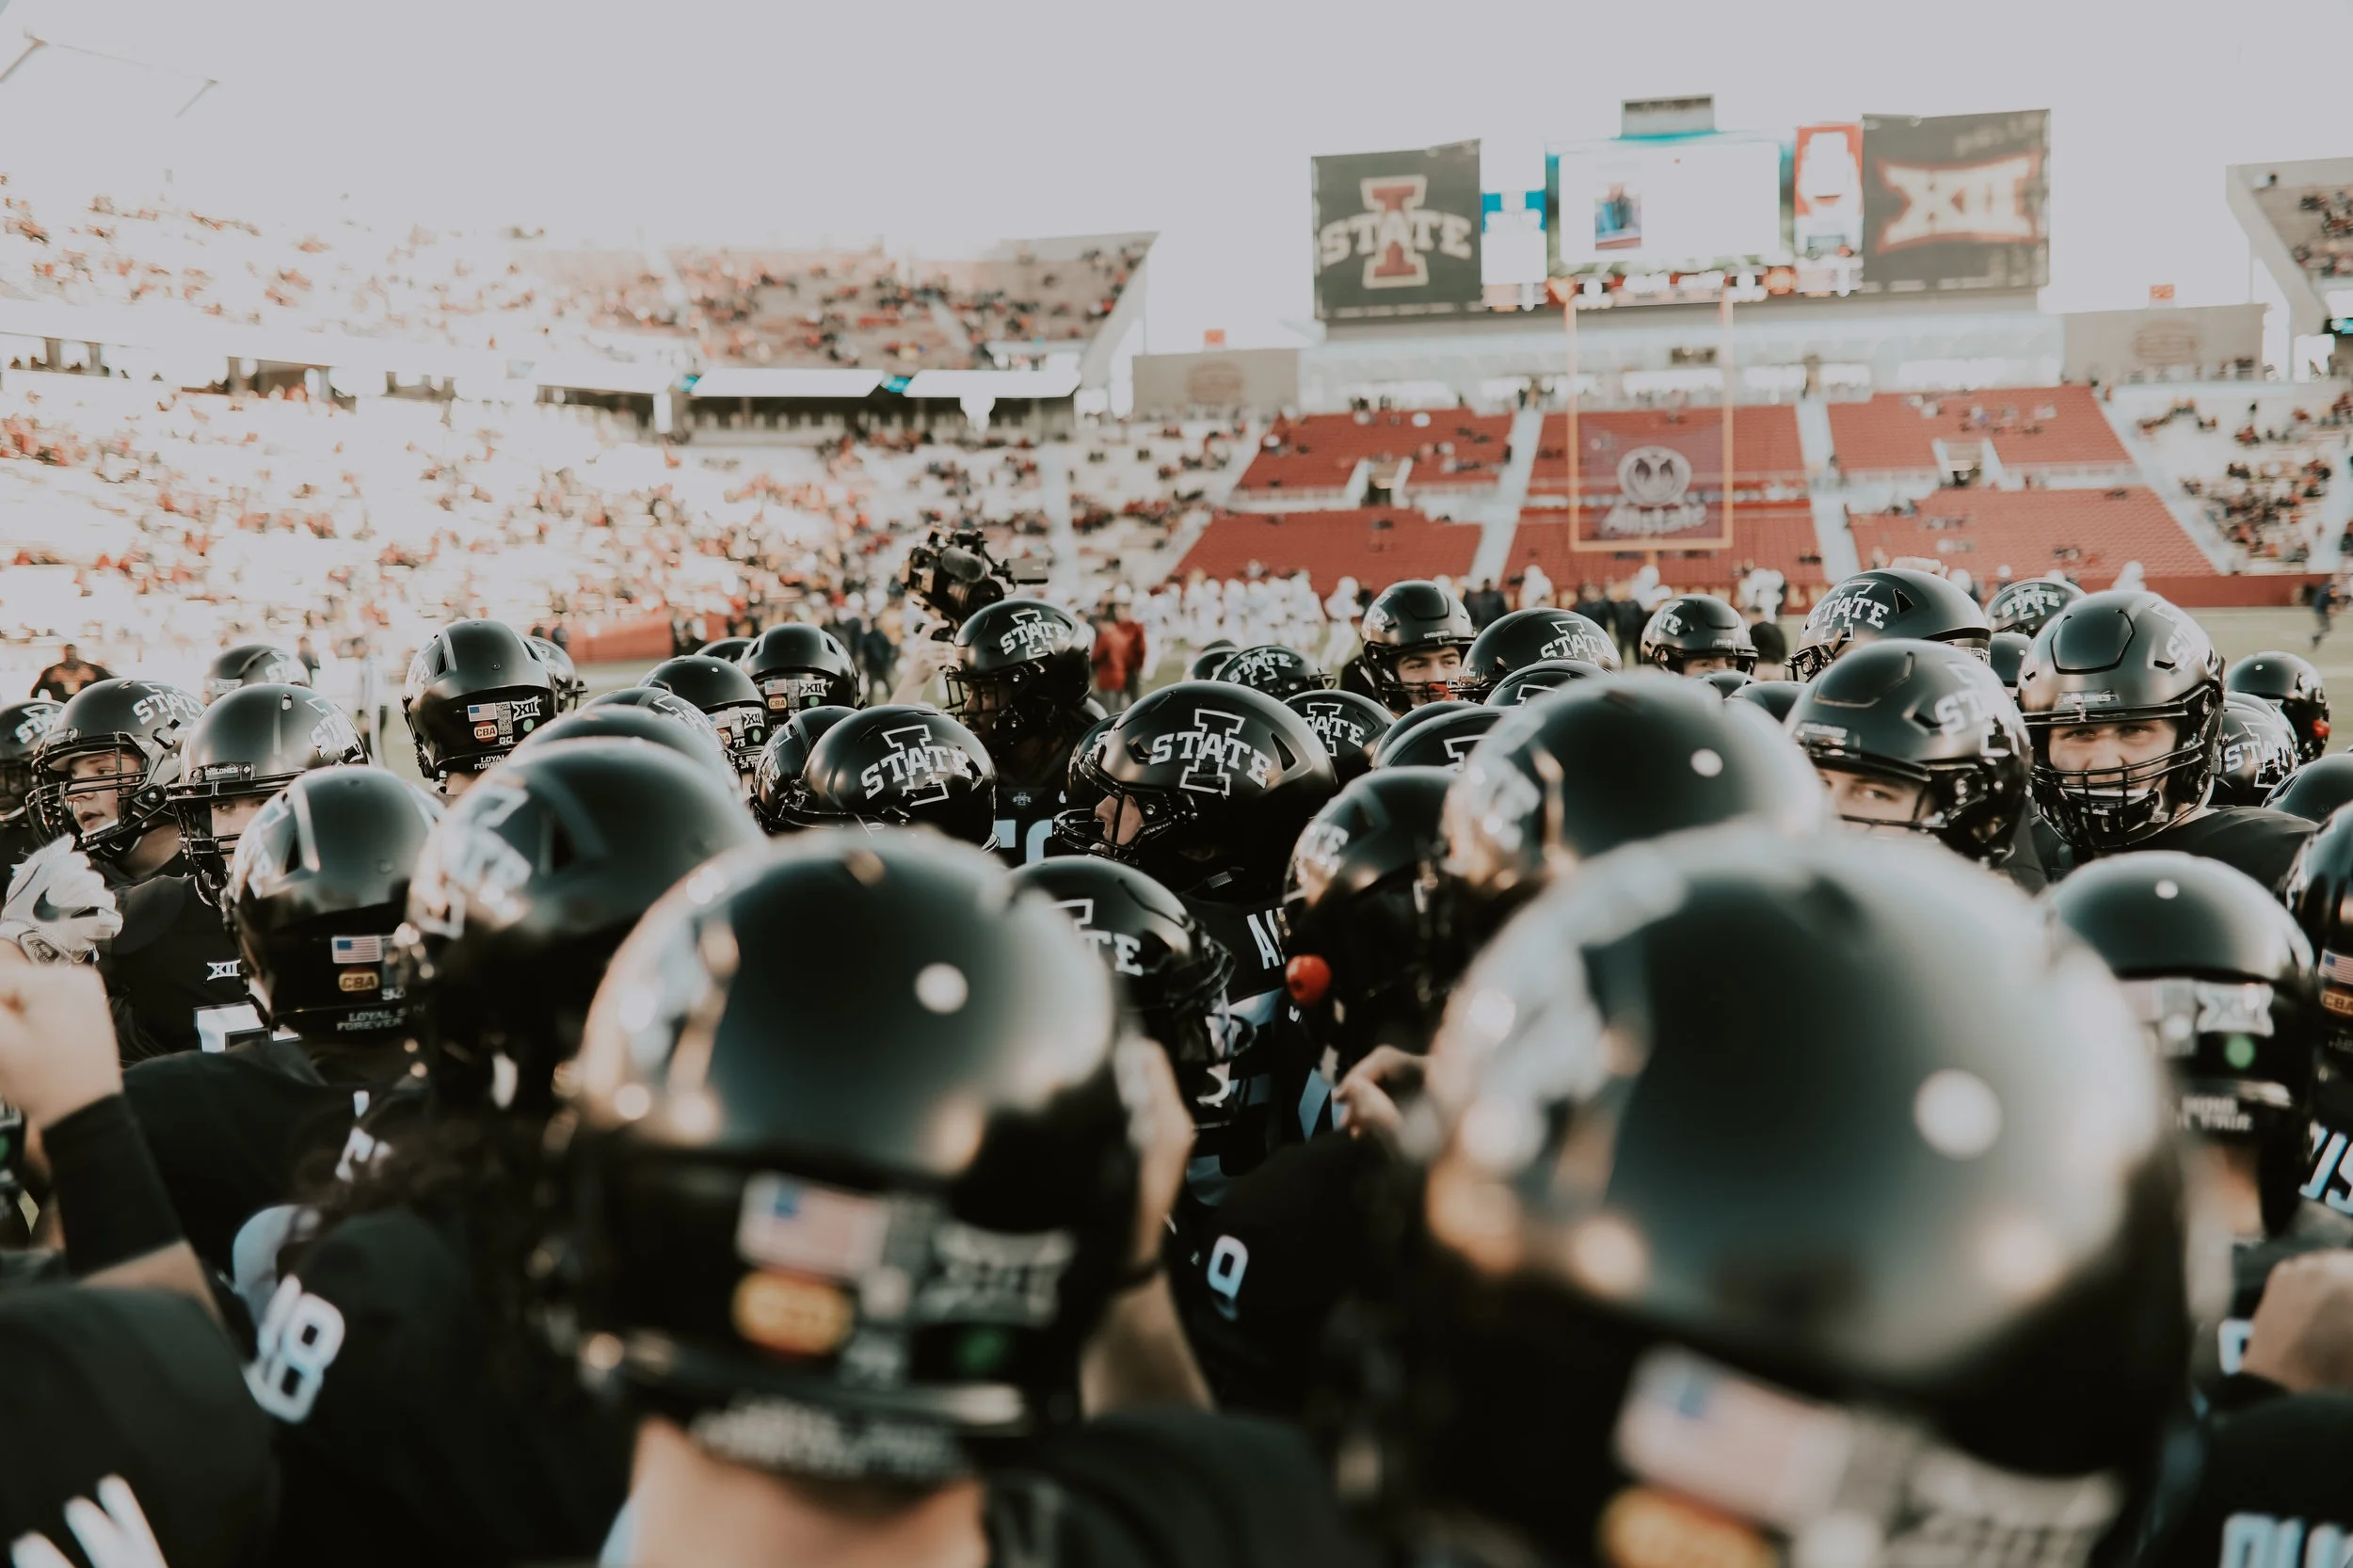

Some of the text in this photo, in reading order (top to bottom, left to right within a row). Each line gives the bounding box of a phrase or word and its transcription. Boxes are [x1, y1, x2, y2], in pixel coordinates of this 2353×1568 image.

[1319, 208, 1472, 267] STATE
[1000, 621, 1069, 656] STATE
[1228, 651, 1293, 684] STATE
[511, 696, 542, 722] XII
[476, 728, 496, 737] CBA
[1303, 715, 1365, 748] TATE
[861, 745, 973, 800] STATE
[1148, 731, 1273, 789] STATE
[206, 958, 242, 982] XII
[342, 977, 377, 990] CBA
